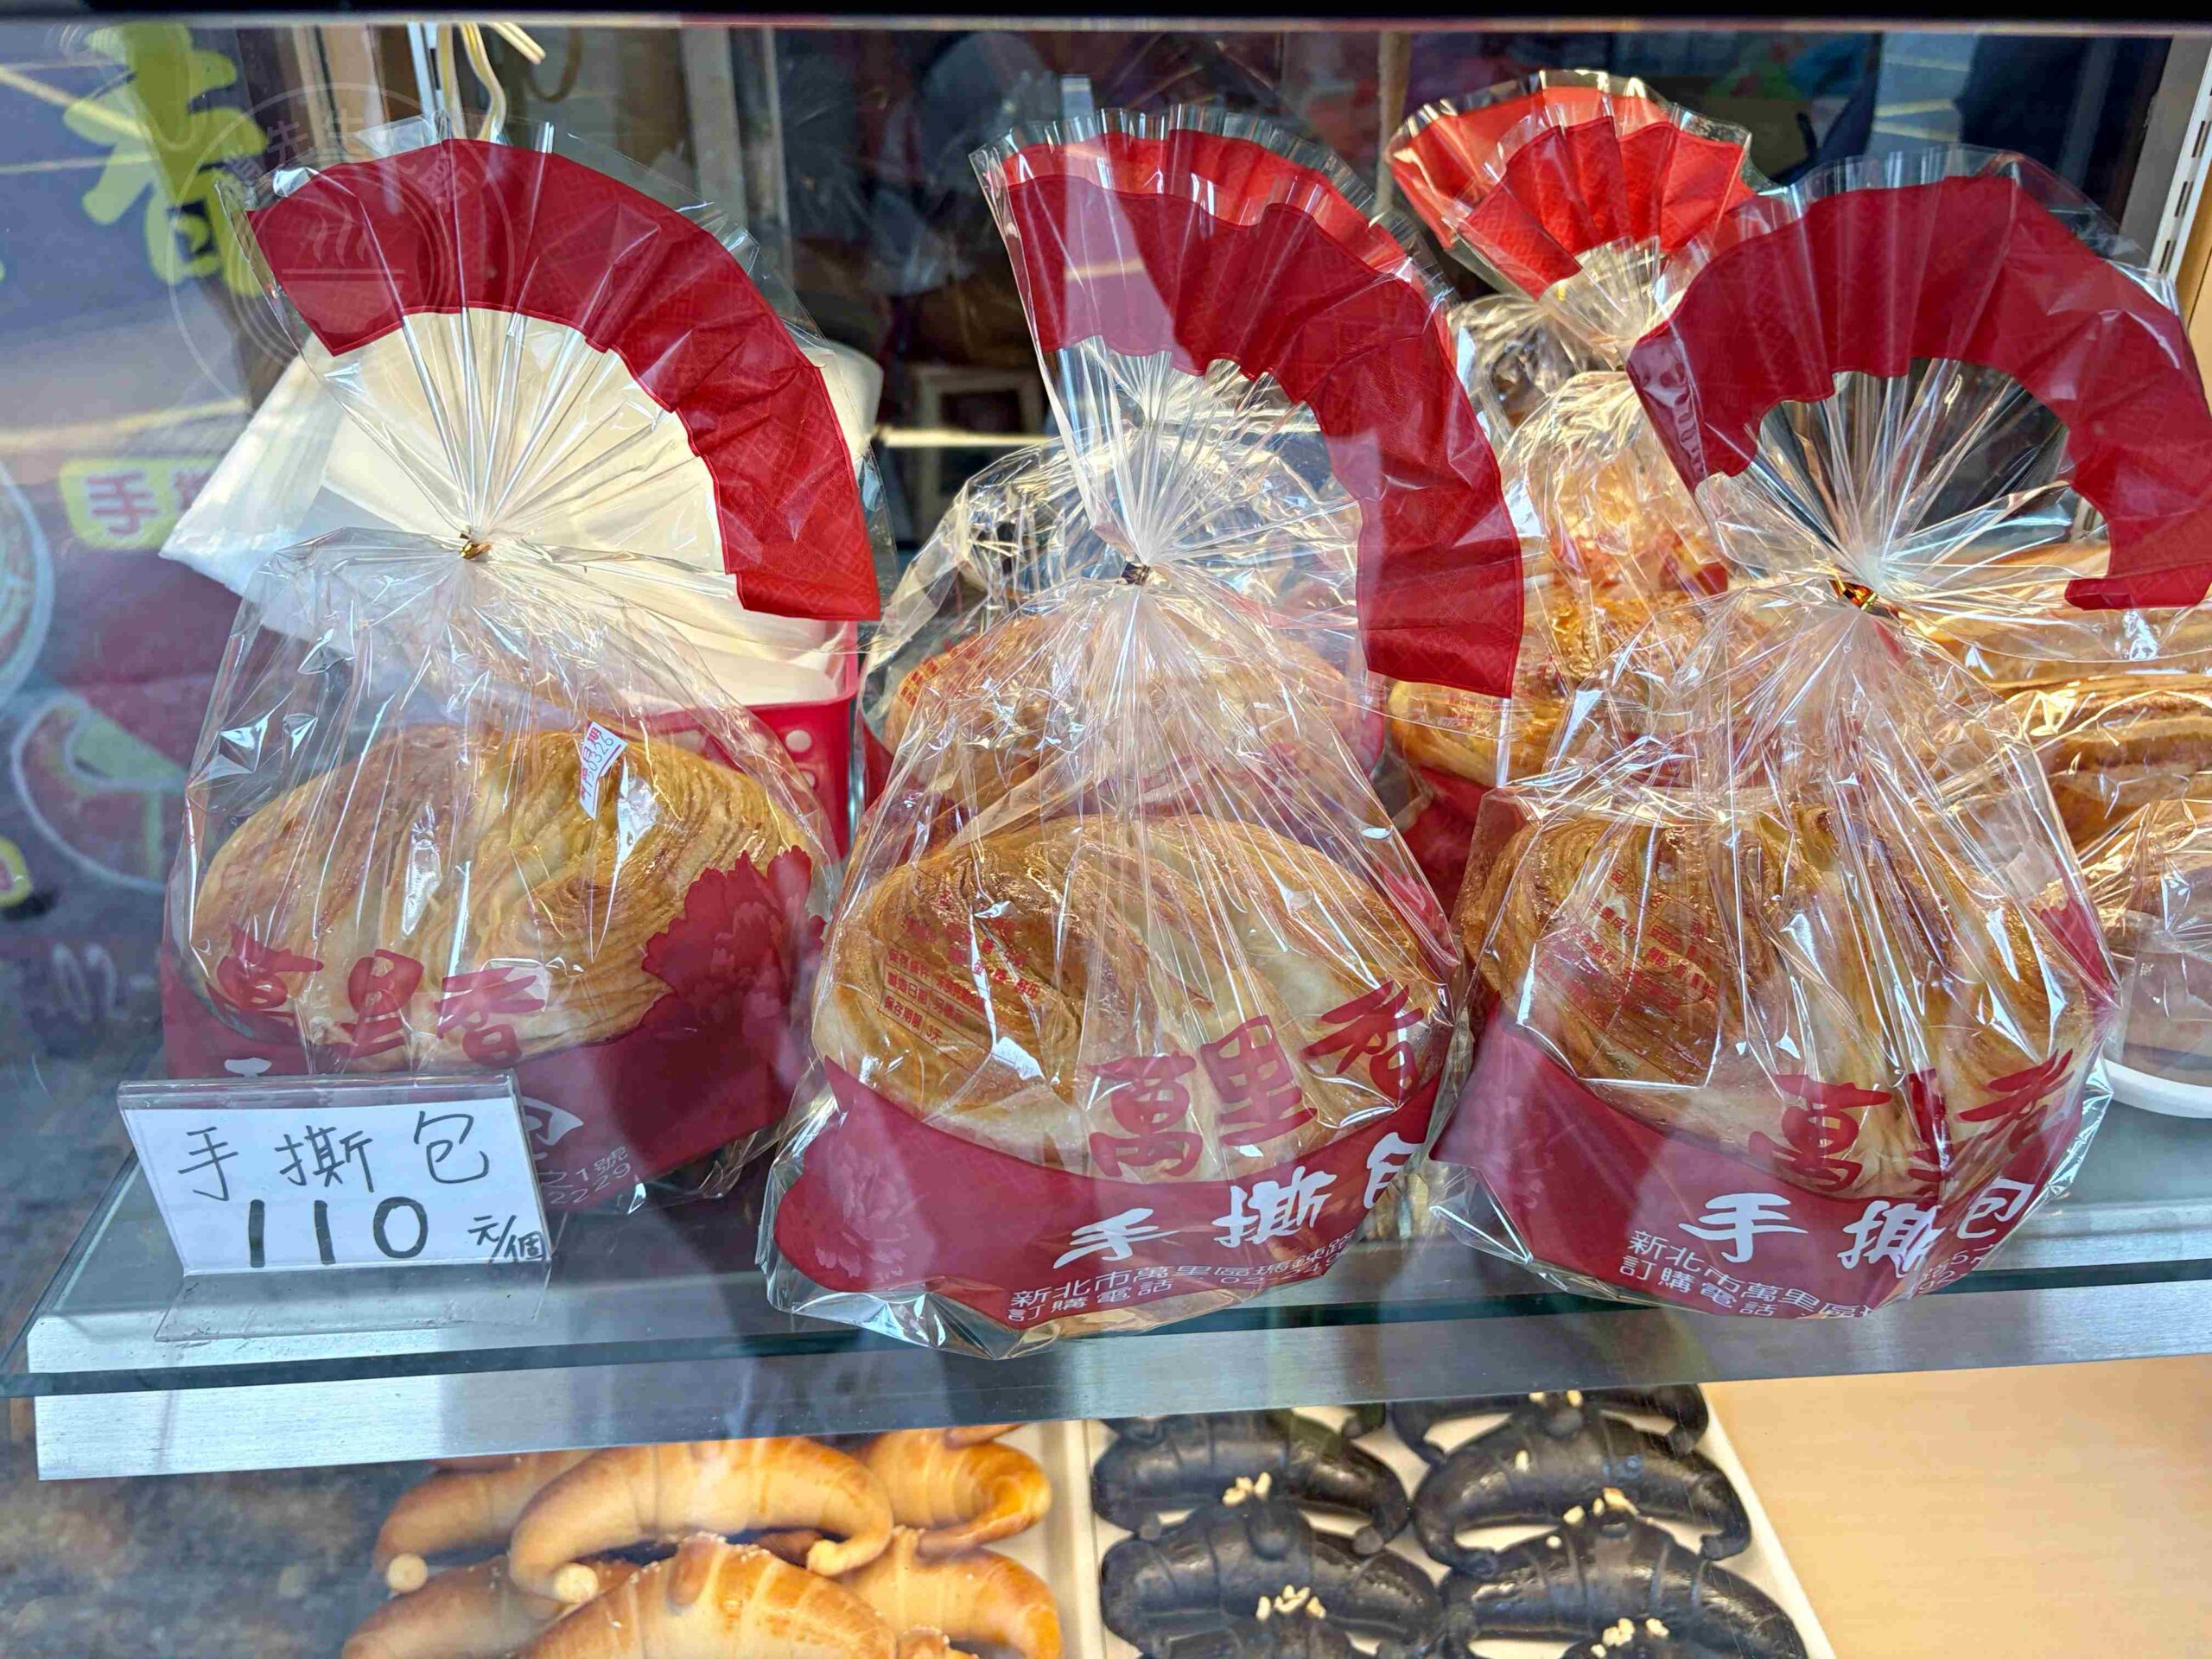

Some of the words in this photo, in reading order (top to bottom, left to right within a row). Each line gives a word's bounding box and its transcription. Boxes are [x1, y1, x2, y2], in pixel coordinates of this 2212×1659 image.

[1083, 980, 1426, 1178] 萬里香
[178, 1110, 491, 1201] 手撕包
[248, 1196, 429, 1268] 110
[1678, 1175, 2036, 1279] 手撕包
